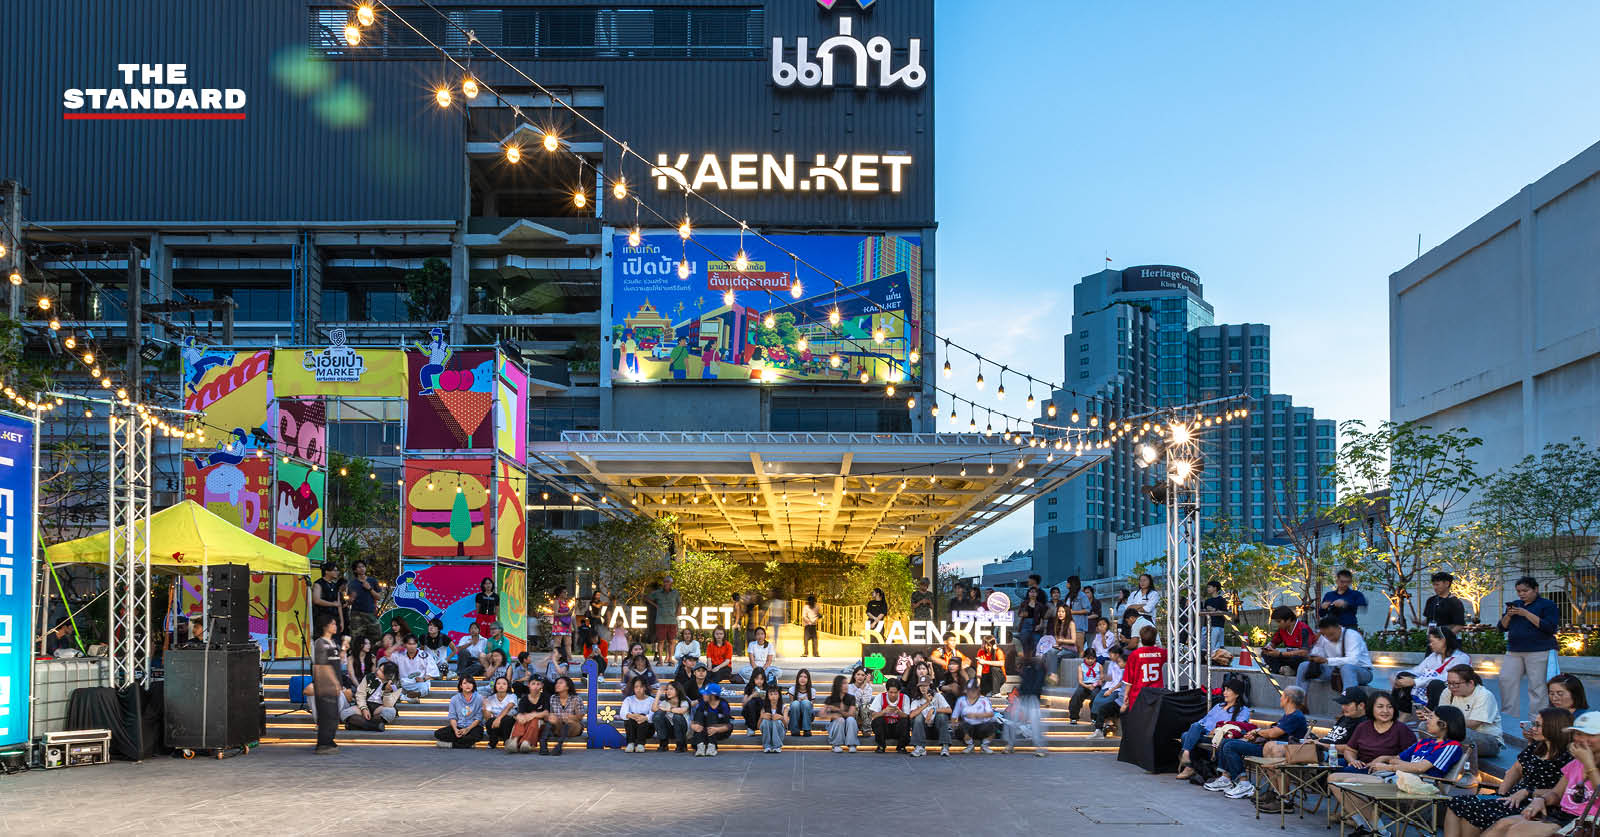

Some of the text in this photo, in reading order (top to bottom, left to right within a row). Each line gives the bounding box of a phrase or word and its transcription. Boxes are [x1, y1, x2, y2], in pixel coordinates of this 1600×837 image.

[772, 17, 927, 89] แก่น
[652, 153, 911, 193] KAEN.KET
[710, 272, 789, 289] ตั้งแต่ตุลาคมนี้
[1141, 268, 1180, 281] Heritage
[316, 368, 362, 376] MARKET
[1141, 663, 1160, 682] 15
